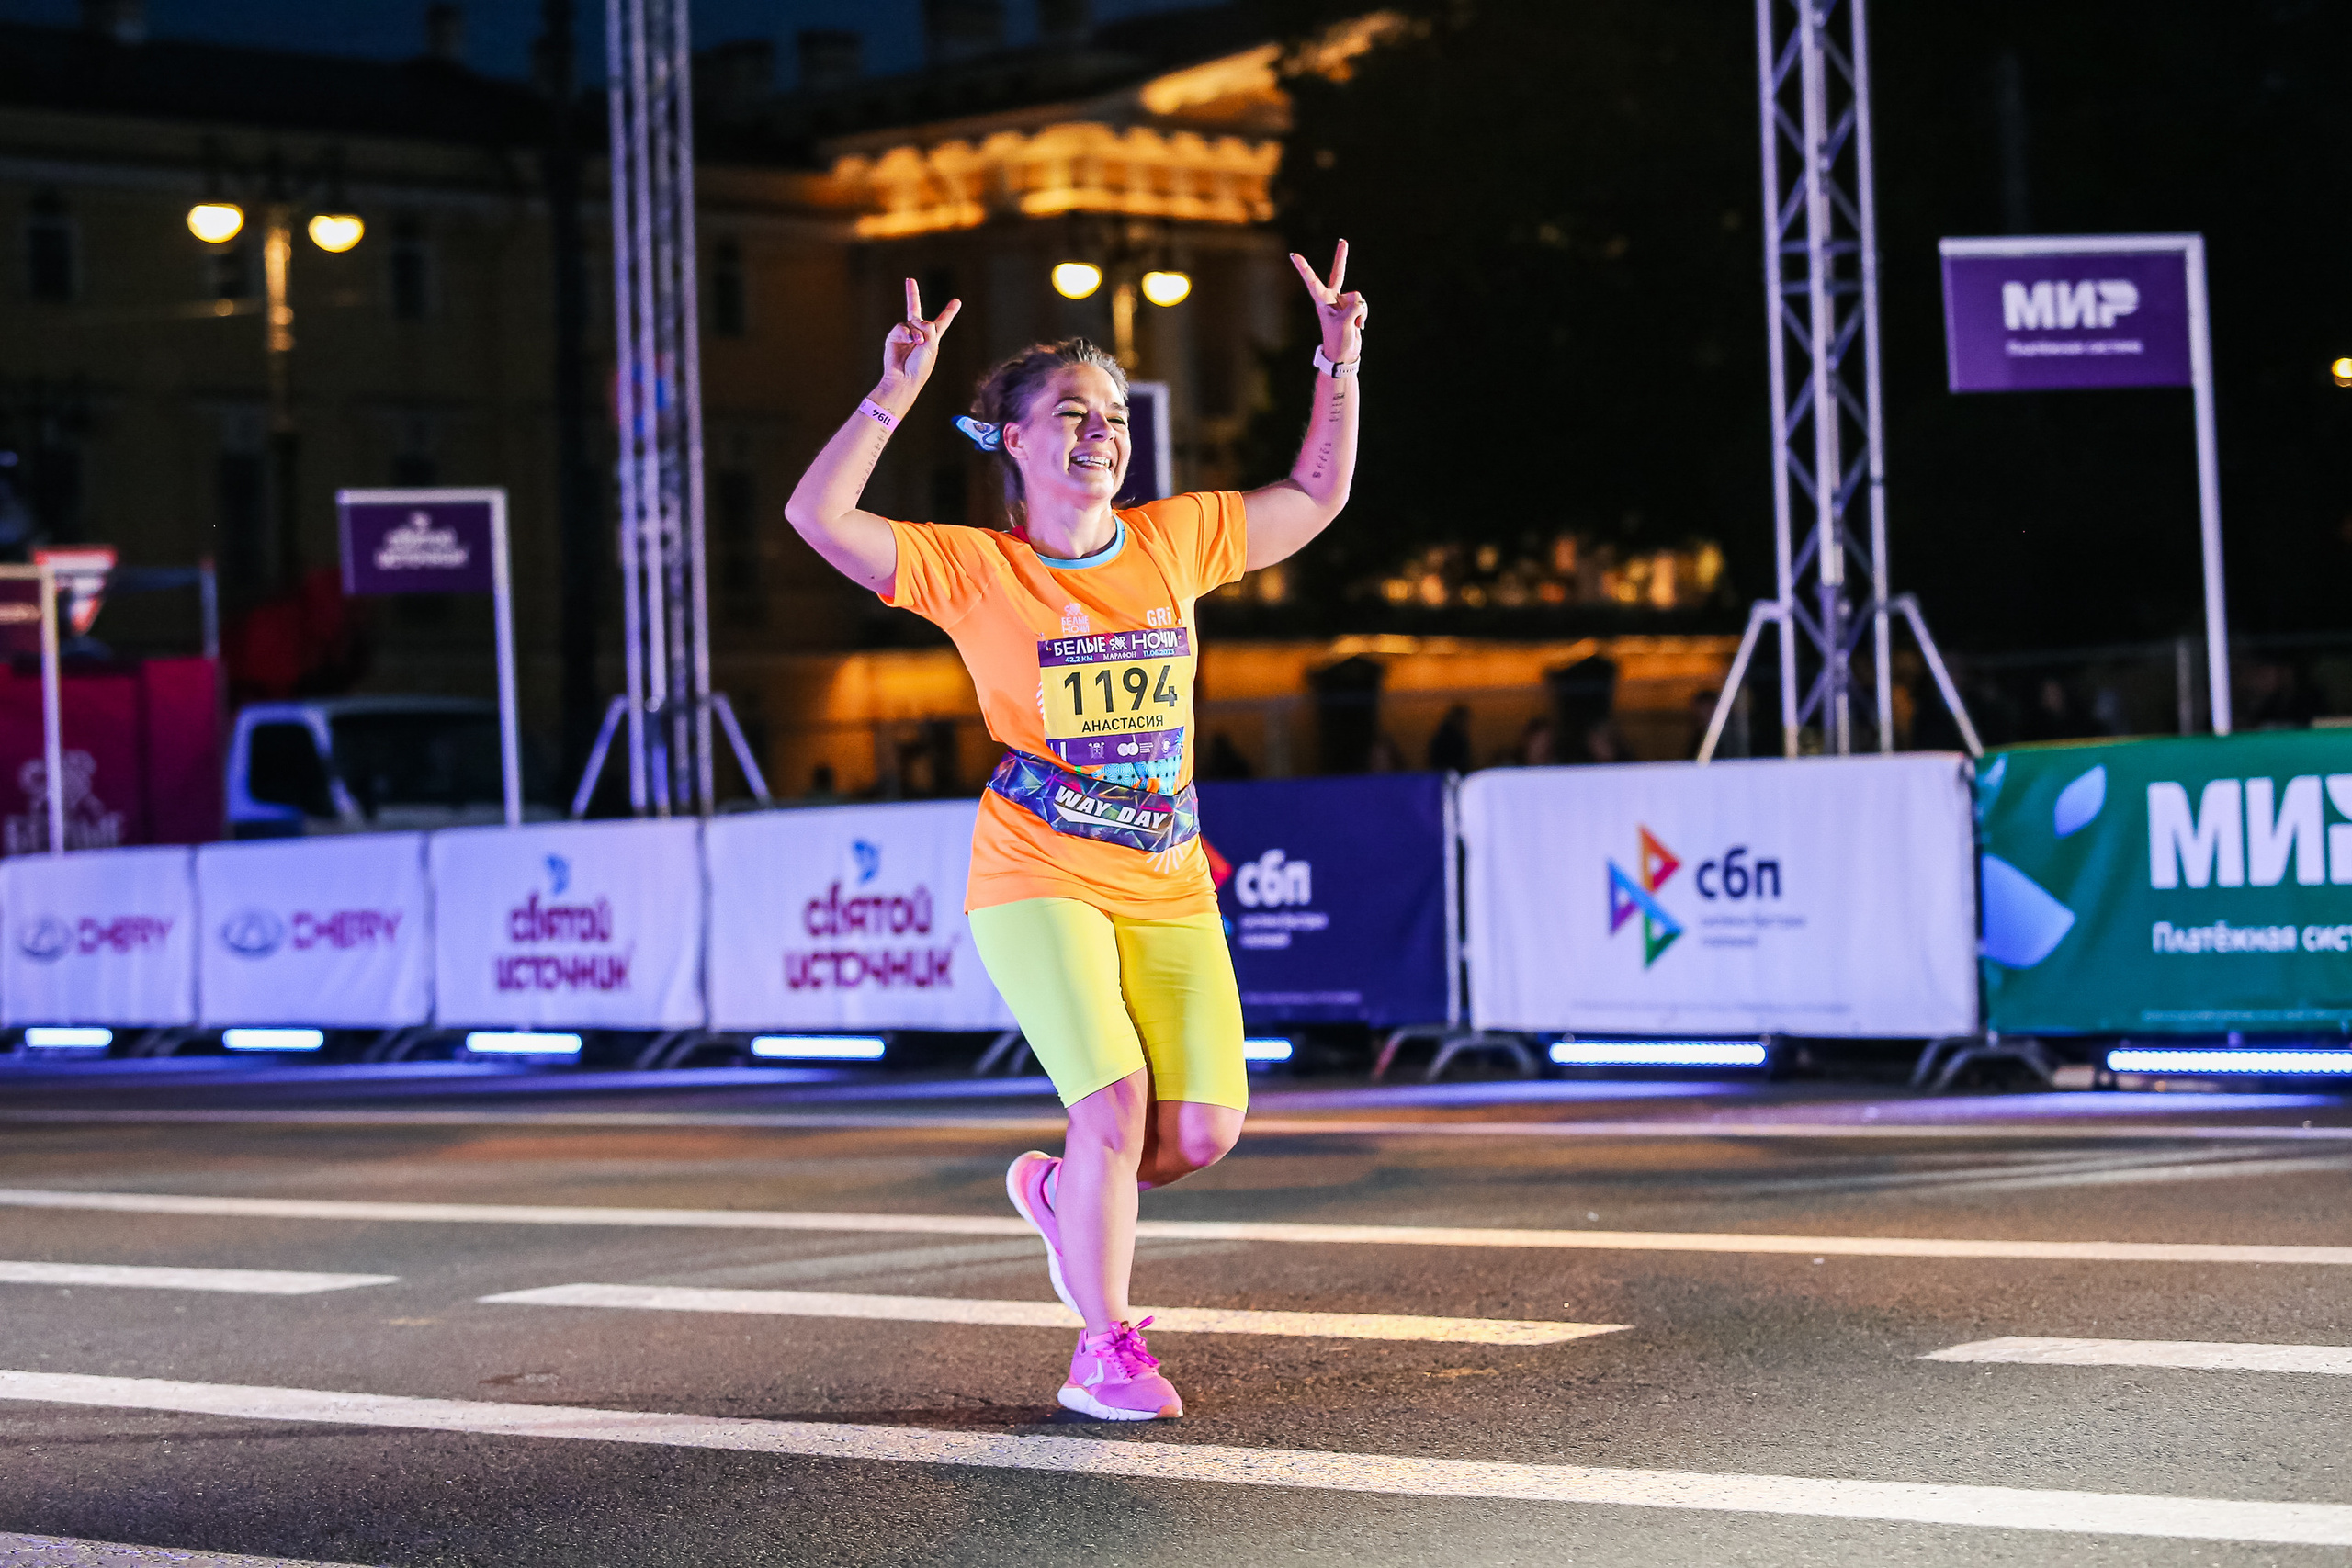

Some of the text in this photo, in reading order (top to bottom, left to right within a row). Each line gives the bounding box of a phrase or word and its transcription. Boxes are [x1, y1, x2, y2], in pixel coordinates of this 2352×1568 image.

[2002, 278, 2140, 331] МИР
[872, 408, 891, 426] 1194
[1061, 616, 1089, 625] БЕЛЫЕ
[1054, 631, 1178, 656] БЕЛЫЕ НОЧИ
[1103, 651, 1136, 660] МАРАФОН
[1064, 665, 1178, 715] 1194
[1081, 715, 1164, 733] АНАСТАСИЯ
[1055, 786, 1169, 829] WAY DAY
[2147, 773, 2352, 889] МИ
[1235, 848, 1312, 908] сбп
[1696, 846, 1781, 899] сбп
